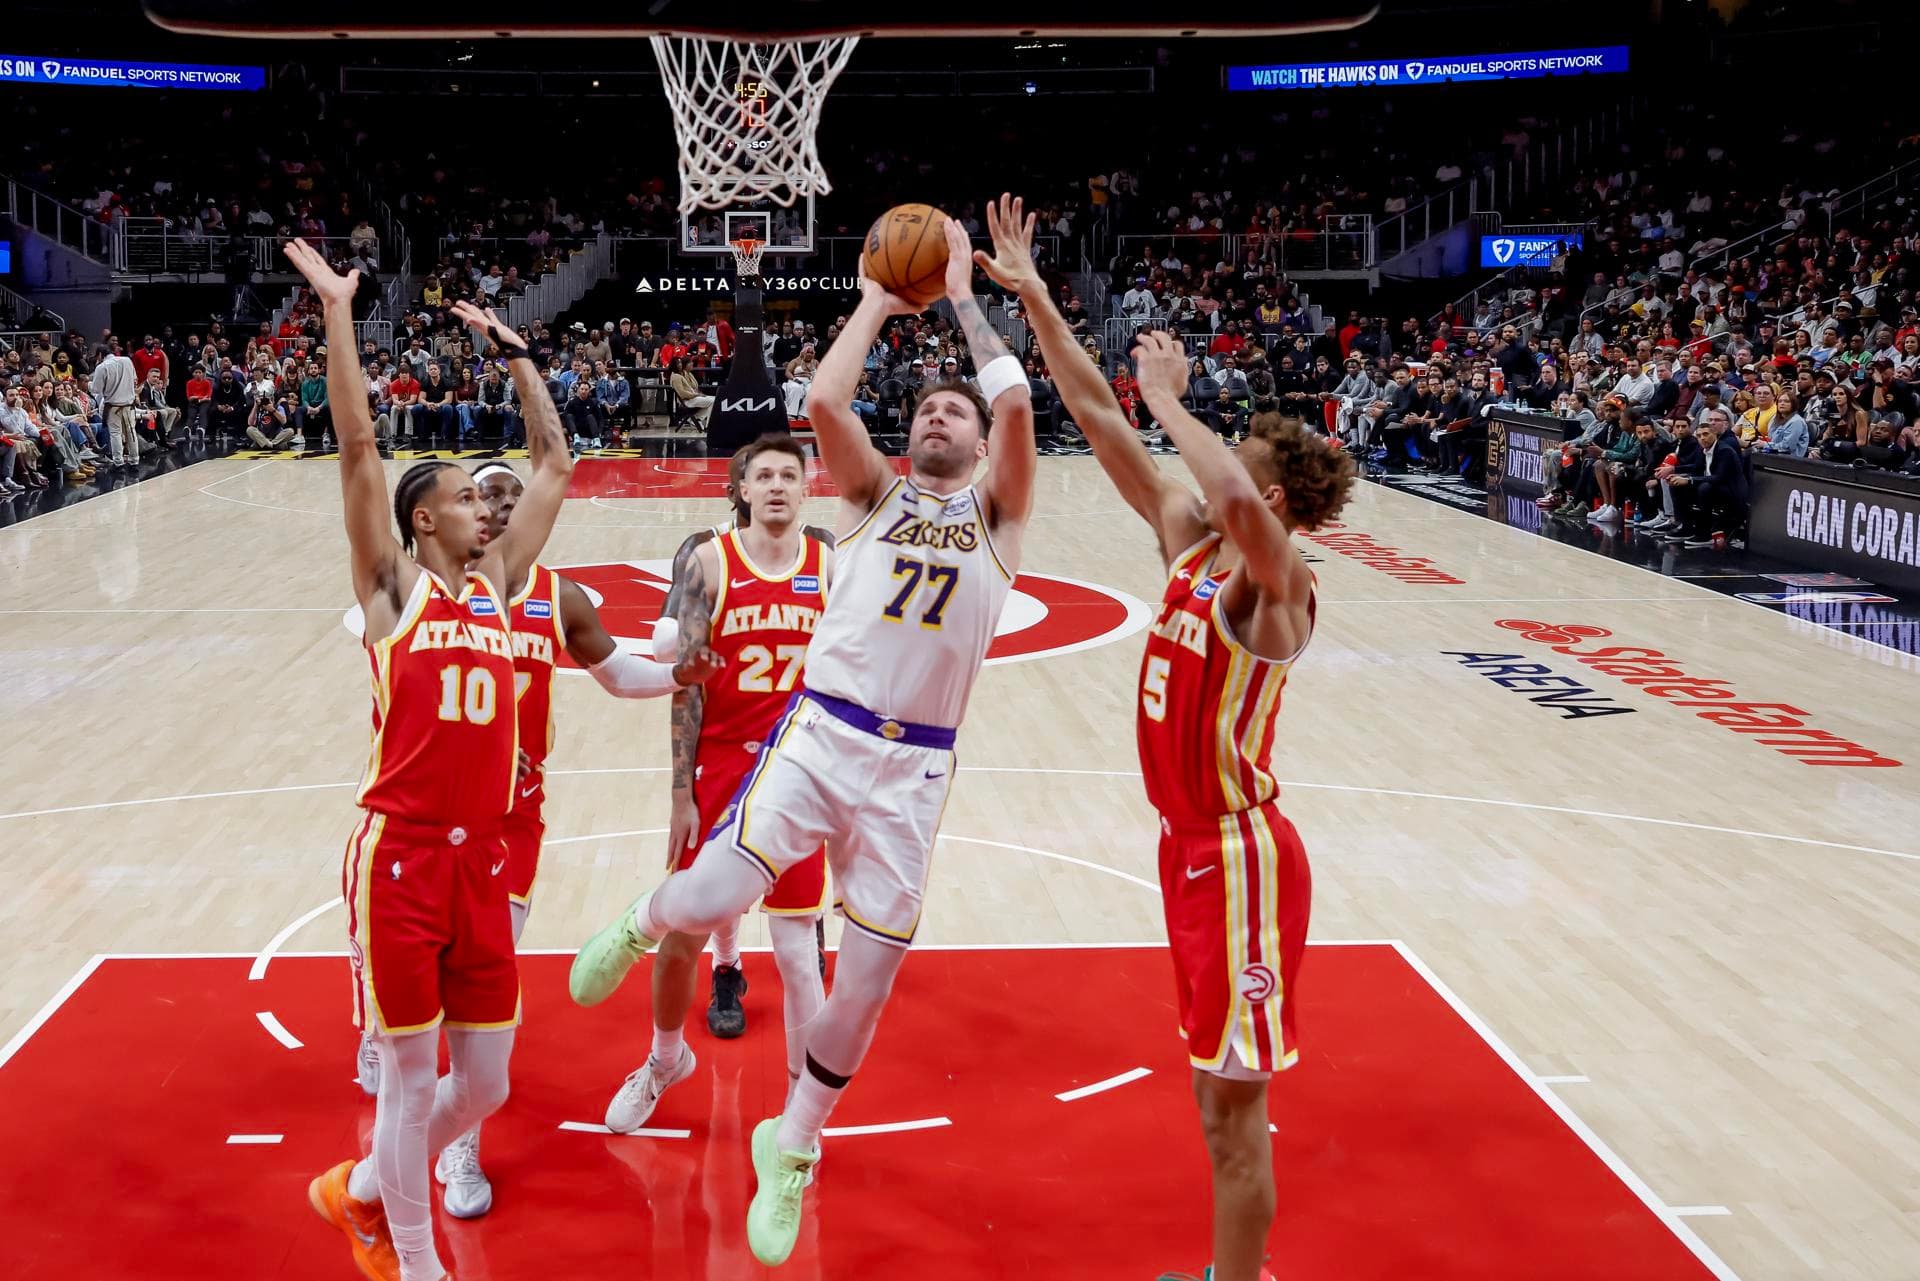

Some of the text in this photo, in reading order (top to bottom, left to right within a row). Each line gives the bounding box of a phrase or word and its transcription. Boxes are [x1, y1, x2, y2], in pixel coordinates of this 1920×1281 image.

[15, 60, 35, 77] ON
[63, 66, 127, 80] FANDUEL
[127, 69, 177, 82] SPORTS
[180, 71, 241, 84] NETWORK
[1251, 54, 1604, 86] WATCH THE HAWKS ON FANDUEL SPORTS NETWORK
[659, 277, 730, 291] DELTA
[721, 397, 776, 412] KIA
[1786, 489, 1920, 568] GRAN CORA
[881, 553, 961, 632] 77
[437, 663, 498, 726] 10
[737, 643, 810, 694] 27
[1142, 654, 1172, 723] 5
[1439, 650, 1639, 720] ARENA
